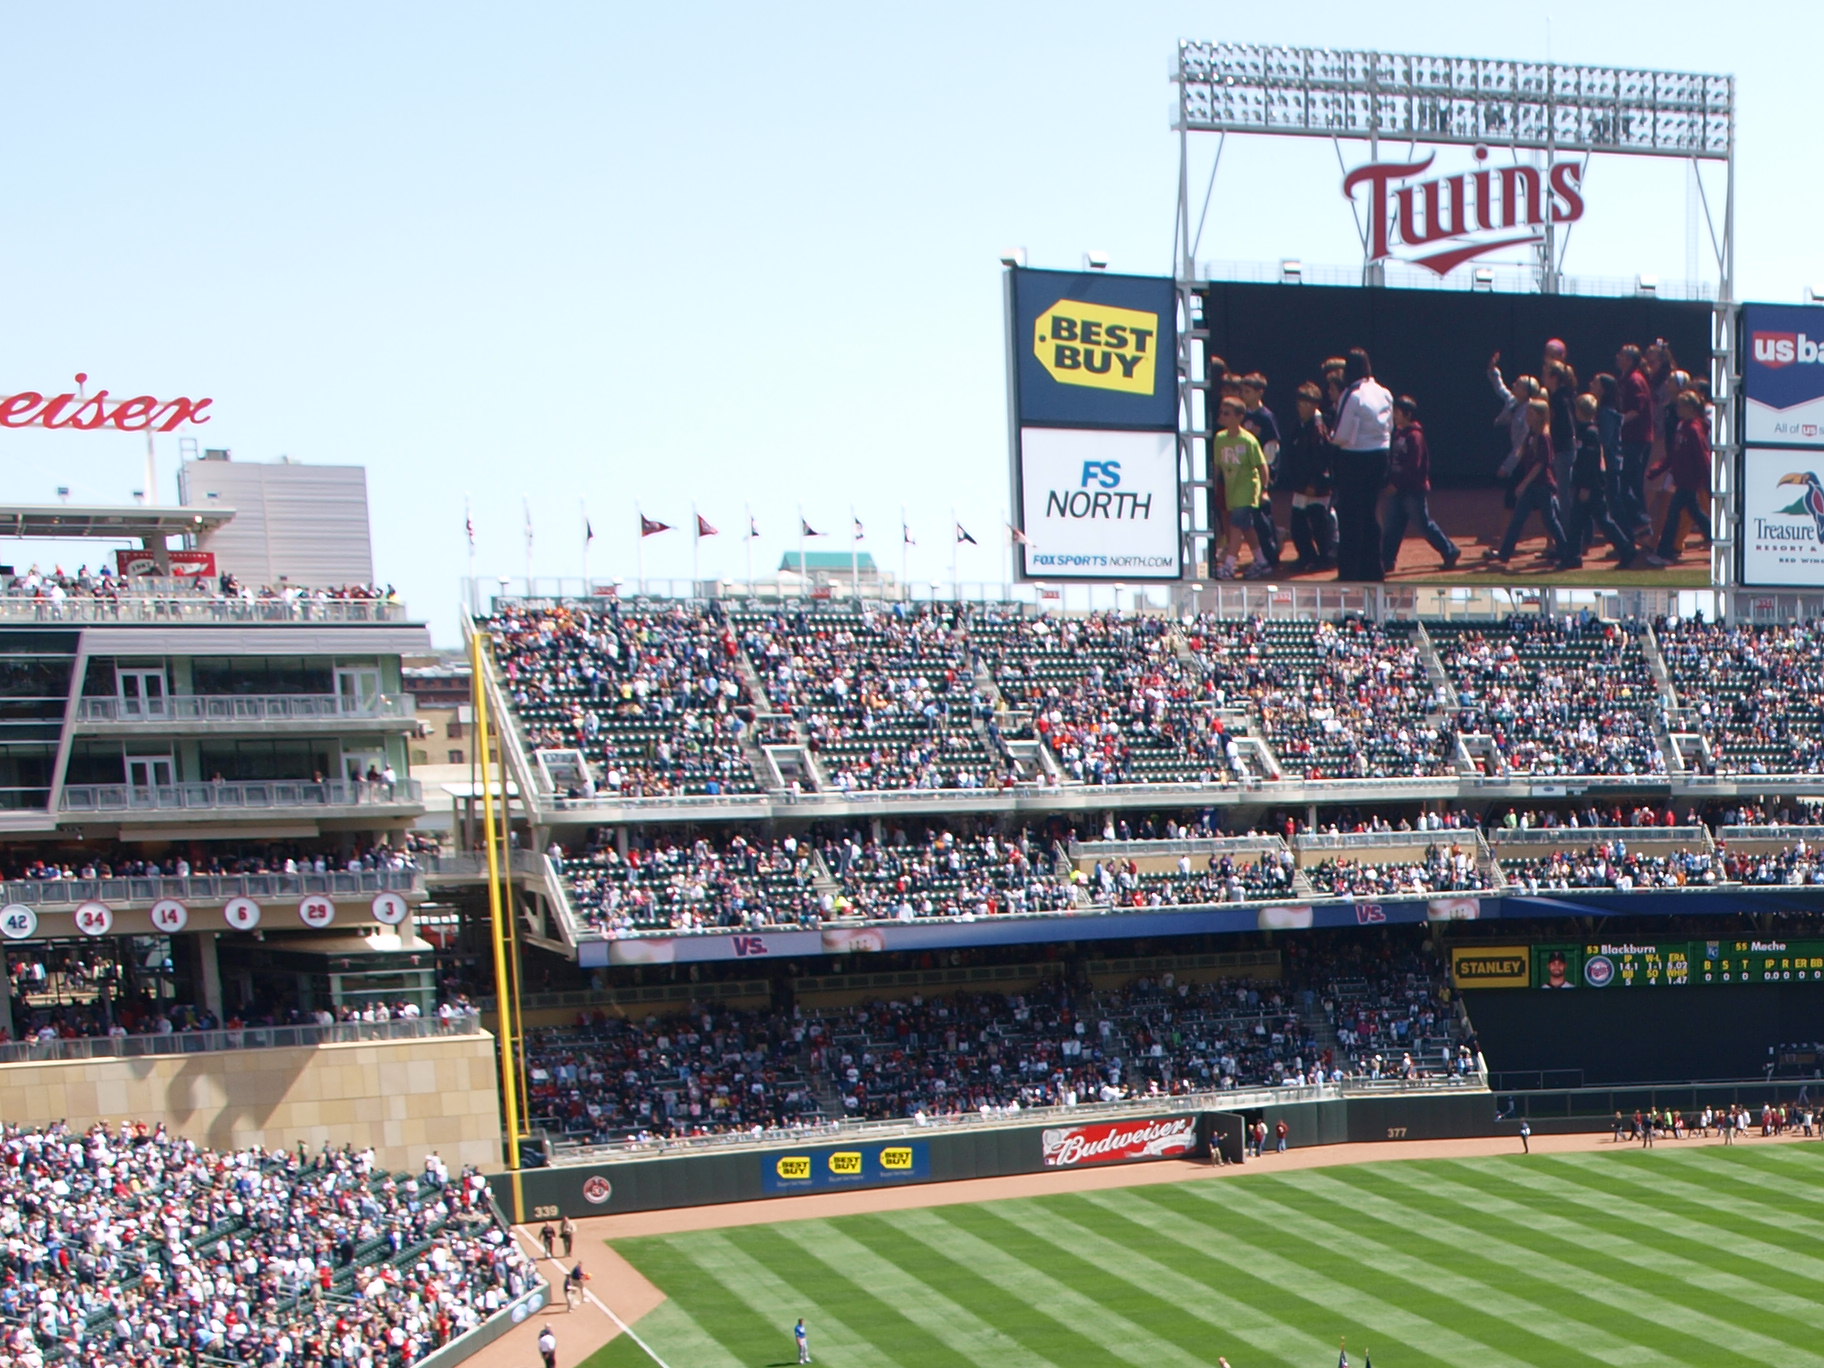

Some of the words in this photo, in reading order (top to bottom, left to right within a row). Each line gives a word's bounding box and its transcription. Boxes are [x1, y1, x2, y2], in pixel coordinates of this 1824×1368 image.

[1343, 144, 1585, 264] Twins
[1051, 315, 1154, 353] BEST
[1054, 343, 1143, 379] BUY
[1081, 460, 1122, 489] FS
[1046, 490, 1152, 520] NORTH
[1754, 518, 1815, 541] Treasure
[237, 907, 248, 921] 6
[307, 904, 327, 919] 29
[385, 902, 395, 916] 3
[7, 915, 28, 929] 42
[83, 912, 106, 926] 34
[160, 910, 178, 924] 14
[1601, 944, 1656, 954] Blackburn
[1668, 953, 1685, 962] ERA
[1460, 960, 1521, 975] STANLEY
[1387, 1127, 1408, 1139] 377
[1053, 1117, 1187, 1165] Budweiser
[885, 1151, 911, 1159] BEST
[834, 1162, 857, 1170] BUY
[534, 1205, 559, 1218] 339
